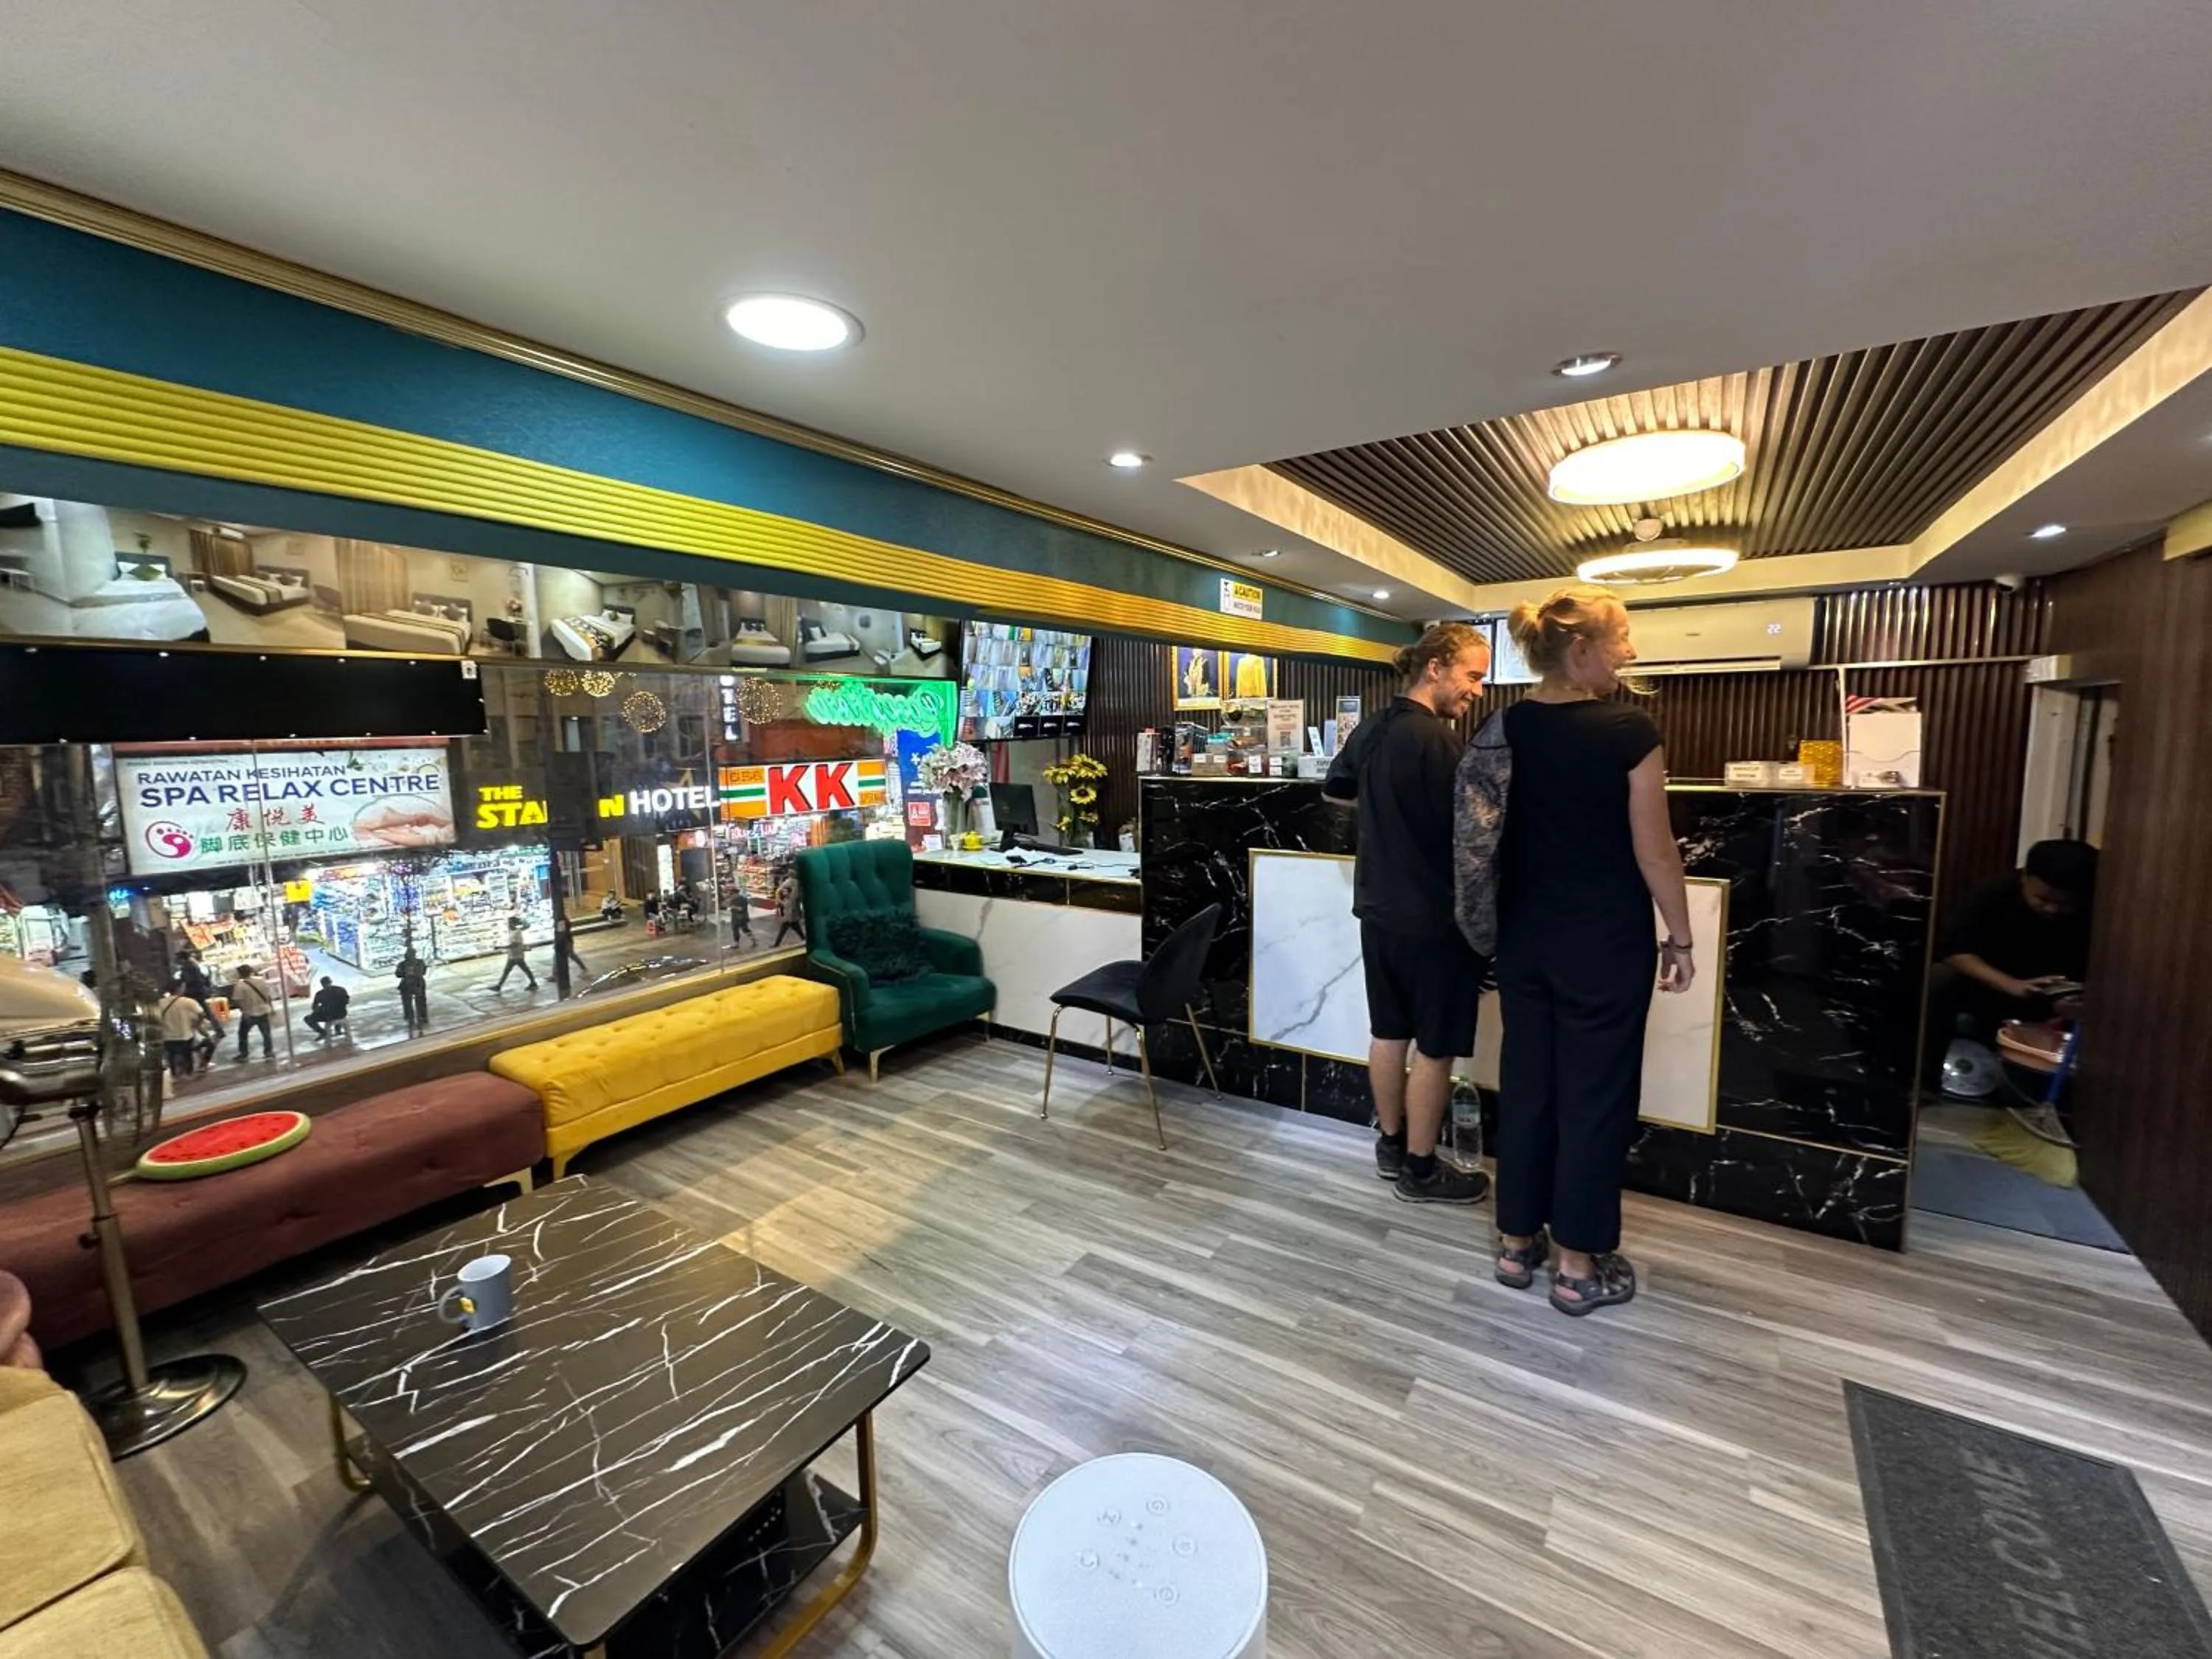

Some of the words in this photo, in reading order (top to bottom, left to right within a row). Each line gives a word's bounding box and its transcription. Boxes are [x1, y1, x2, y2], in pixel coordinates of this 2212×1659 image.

[720, 674, 739, 741] OTEL
[137, 769, 241, 785] RAWATAN
[246, 765, 347, 780] KESIHATAN
[140, 785, 211, 808] SPA
[218, 779, 324, 804] RELAX
[330, 774, 440, 796] CENTRE
[768, 762, 855, 815] KK
[478, 785, 523, 801] THE
[628, 785, 720, 815] HOTEL
